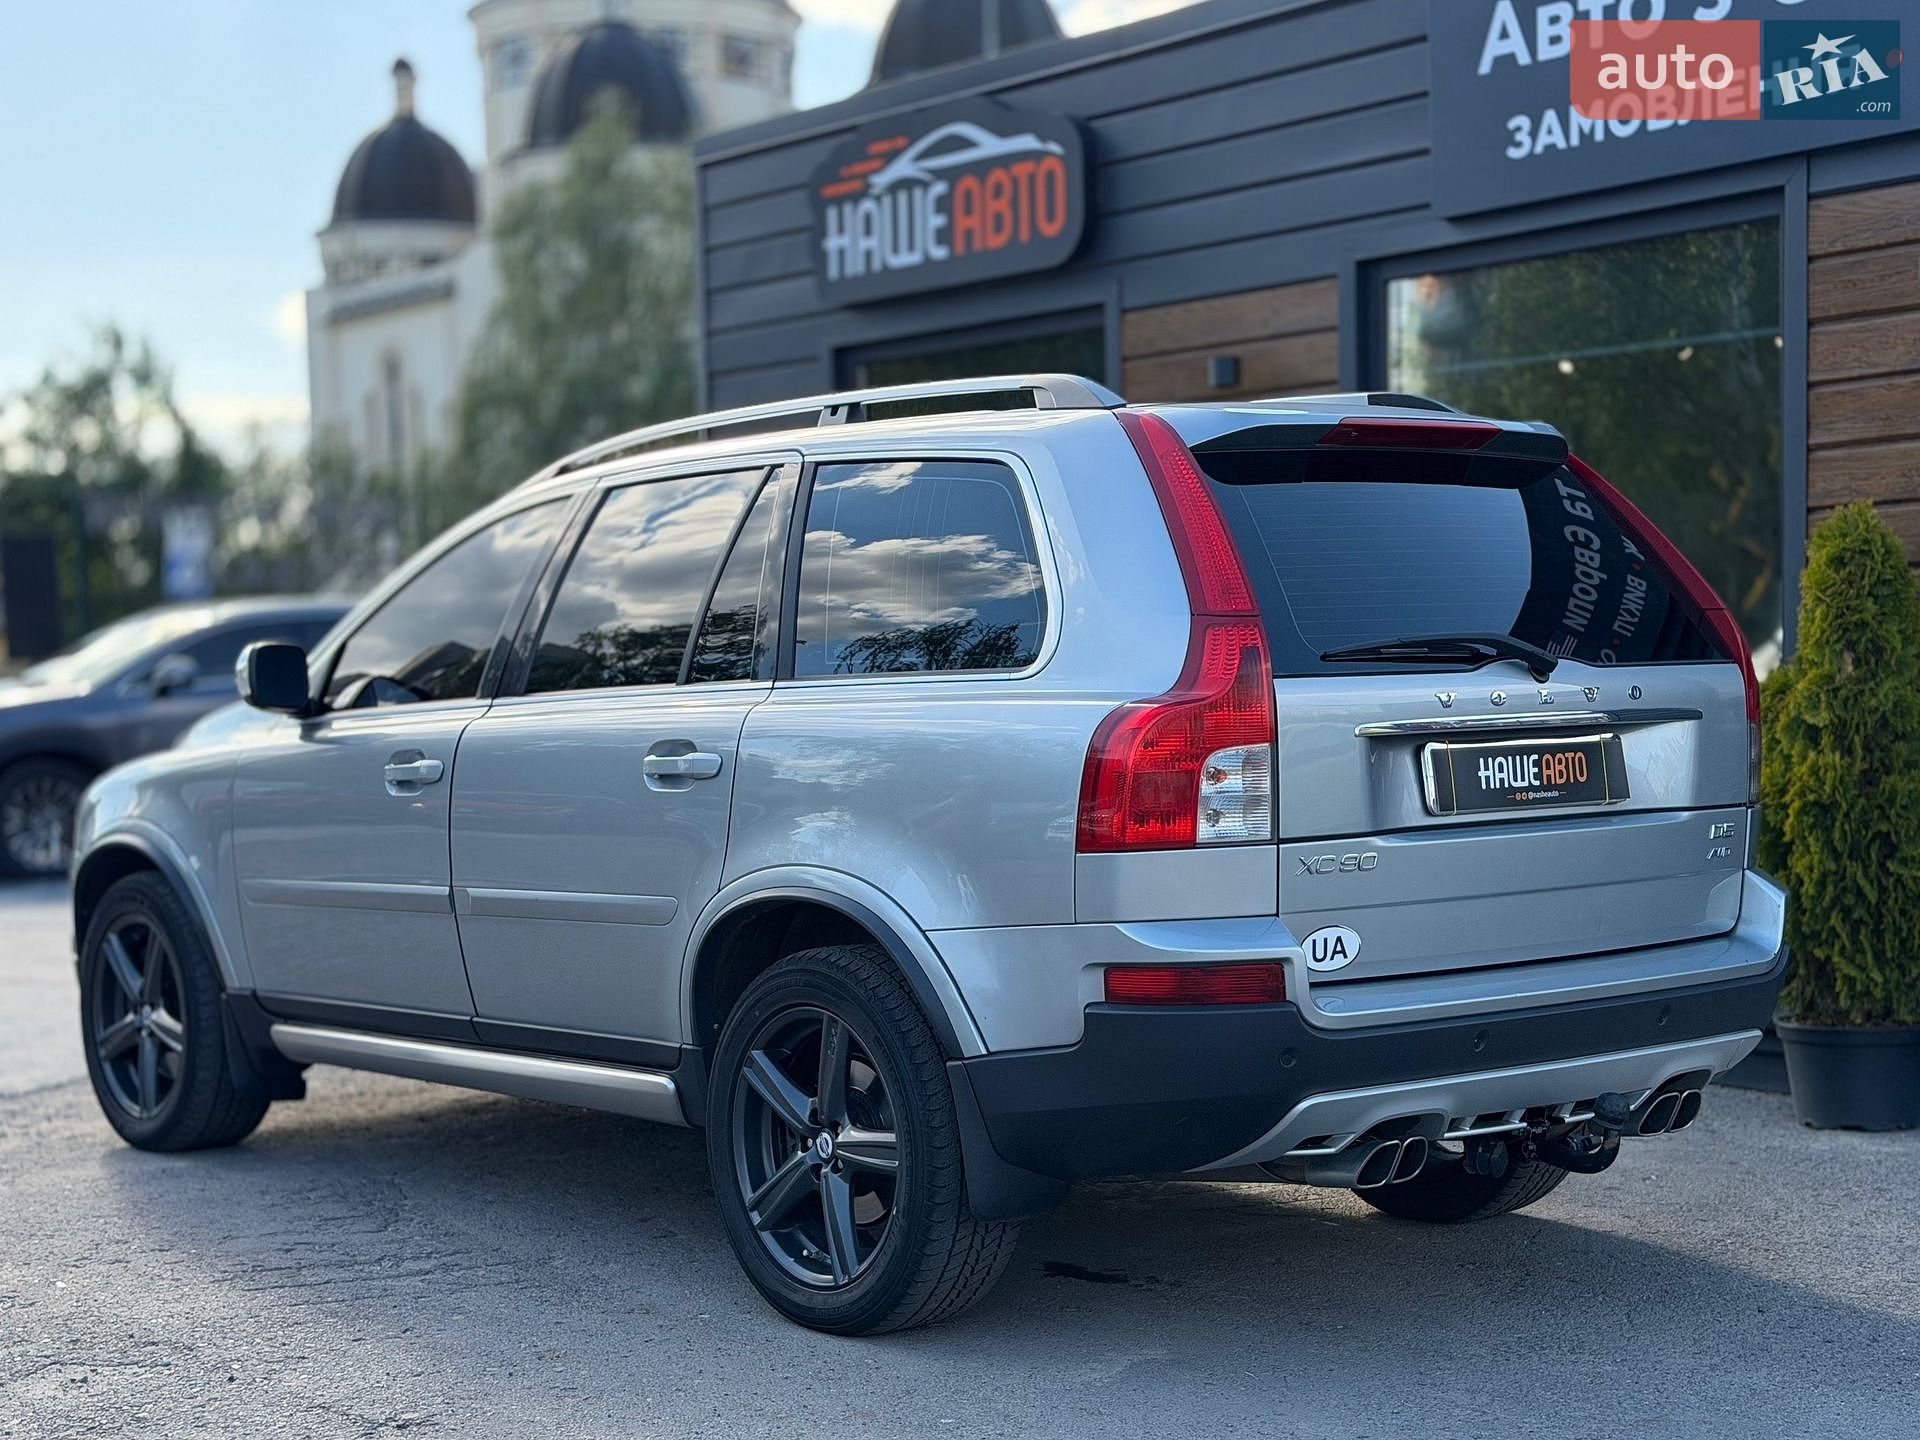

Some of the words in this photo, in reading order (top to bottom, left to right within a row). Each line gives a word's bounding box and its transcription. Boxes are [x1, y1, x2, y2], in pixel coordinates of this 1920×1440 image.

[822, 179, 950, 282] НАШЕ
[952, 155, 1068, 256] АВТО
[1434, 685, 1643, 709] VOLVO
[1478, 754, 1540, 790] НАШЕ
[1542, 751, 1588, 785] АВТО
[1295, 852, 1378, 877] XC90
[1312, 935, 1348, 963] UA
